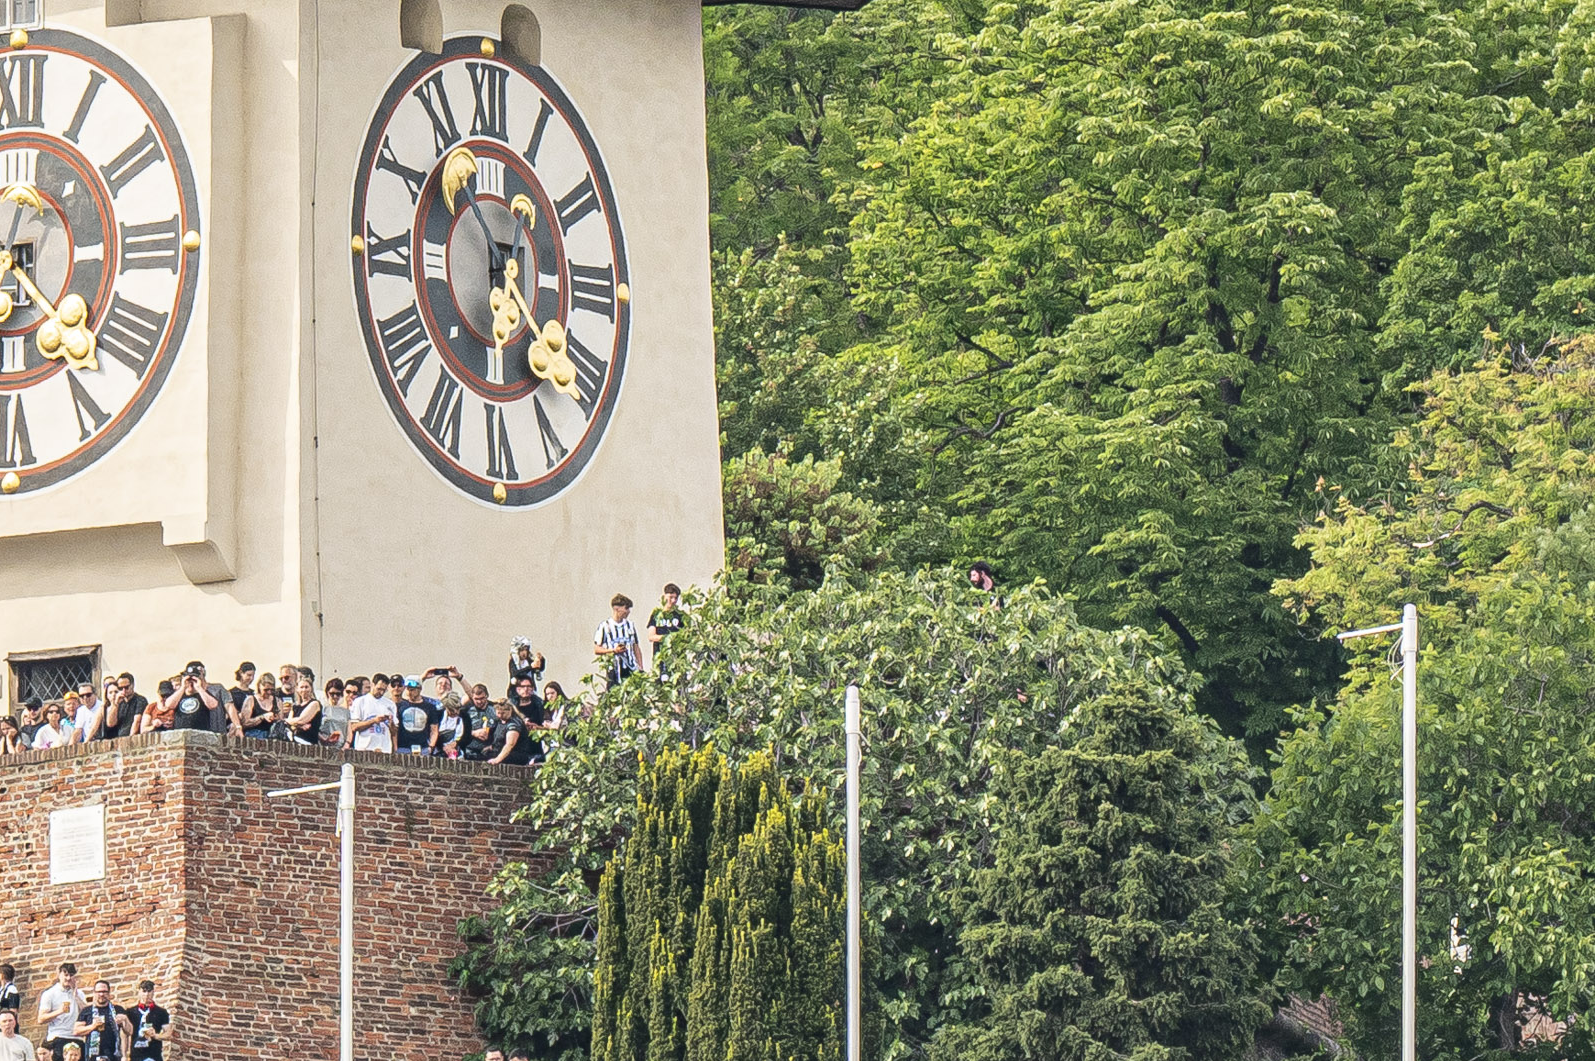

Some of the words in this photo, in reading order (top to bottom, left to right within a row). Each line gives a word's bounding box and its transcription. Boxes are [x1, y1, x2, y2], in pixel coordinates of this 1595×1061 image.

[62, 69, 107, 145] I
[413, 69, 461, 160] XI
[465, 62, 509, 144] XII
[523, 98, 554, 168] I
[99, 123, 165, 200] II
[375, 134, 427, 206] X
[553, 171, 601, 237] II
[119, 214, 179, 275] III
[366, 220, 412, 282] IX
[568, 258, 615, 324] III
[96, 291, 168, 380] IIII
[376, 299, 432, 399] VIII
[66, 369, 112, 442] V
[420, 363, 463, 461] VII
[483, 402, 519, 480] VI
[533, 394, 568, 470] V
